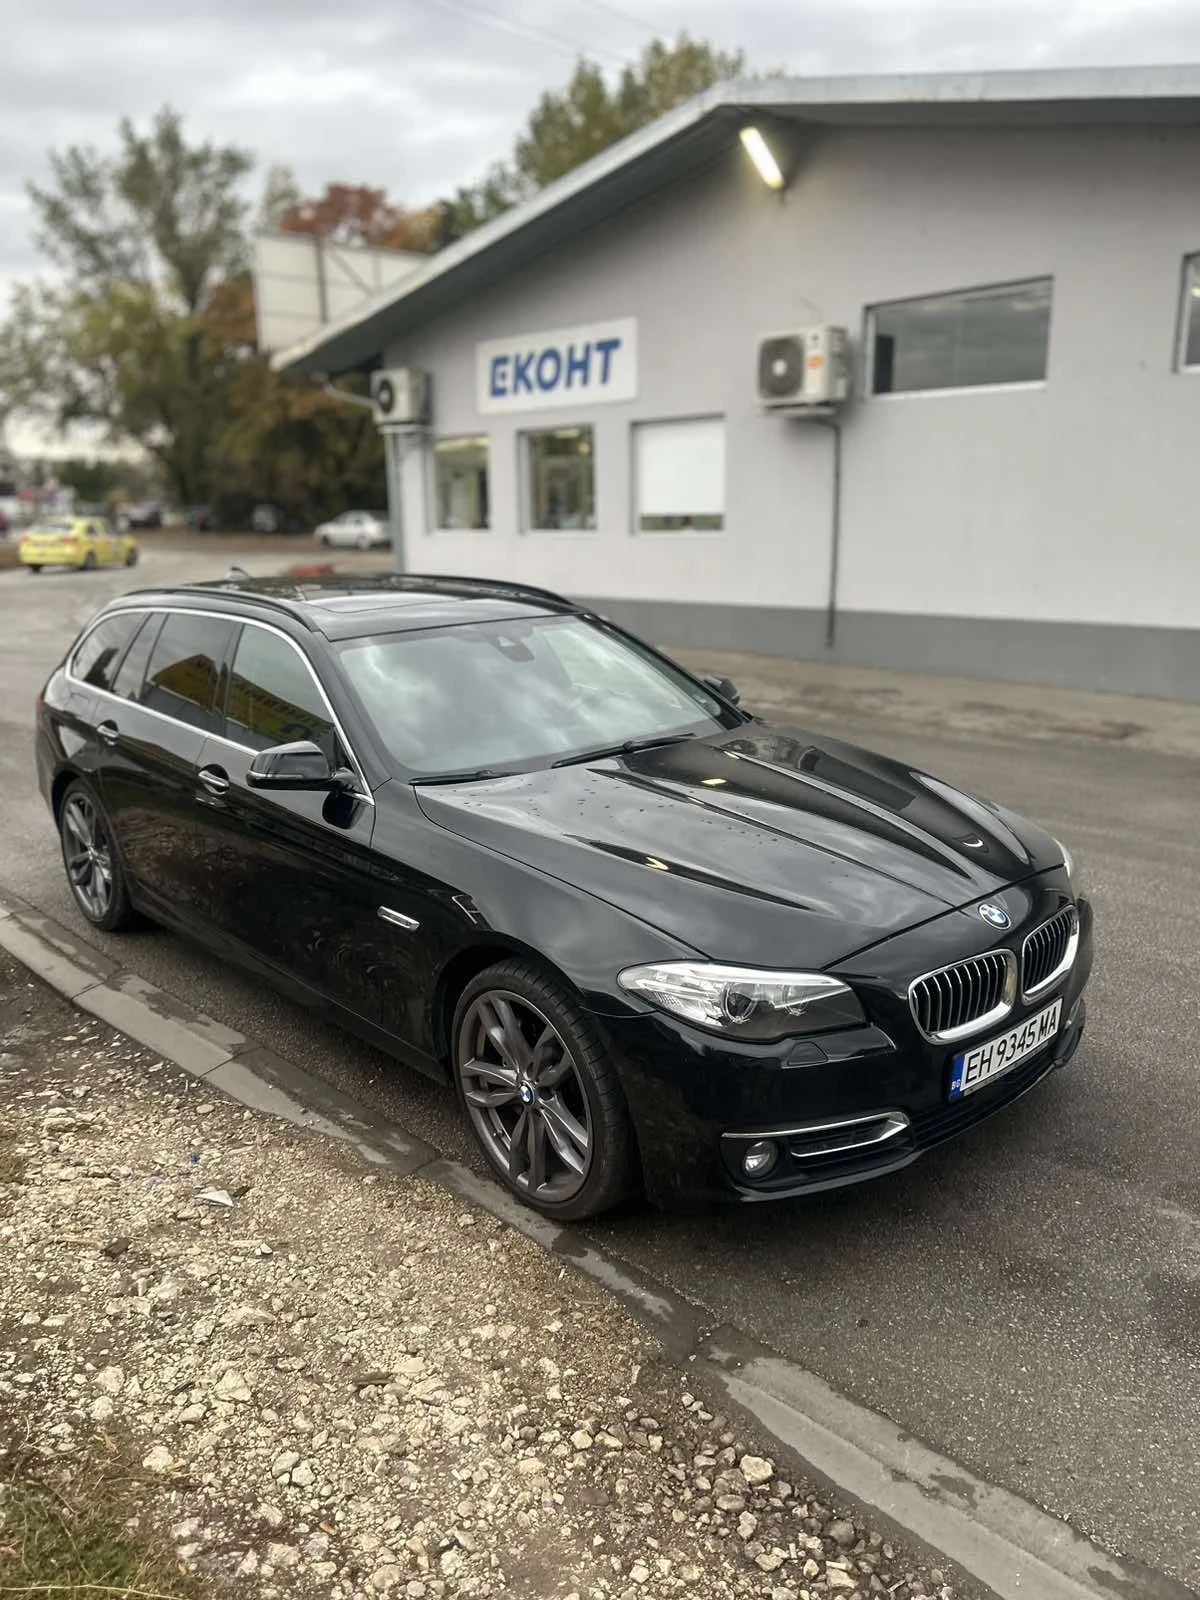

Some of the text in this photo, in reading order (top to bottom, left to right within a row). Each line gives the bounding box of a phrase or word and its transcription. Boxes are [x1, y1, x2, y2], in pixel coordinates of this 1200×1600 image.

[490, 338, 621, 396] ЕКОНТ
[966, 1006, 1057, 1083] EH 9345 MA
